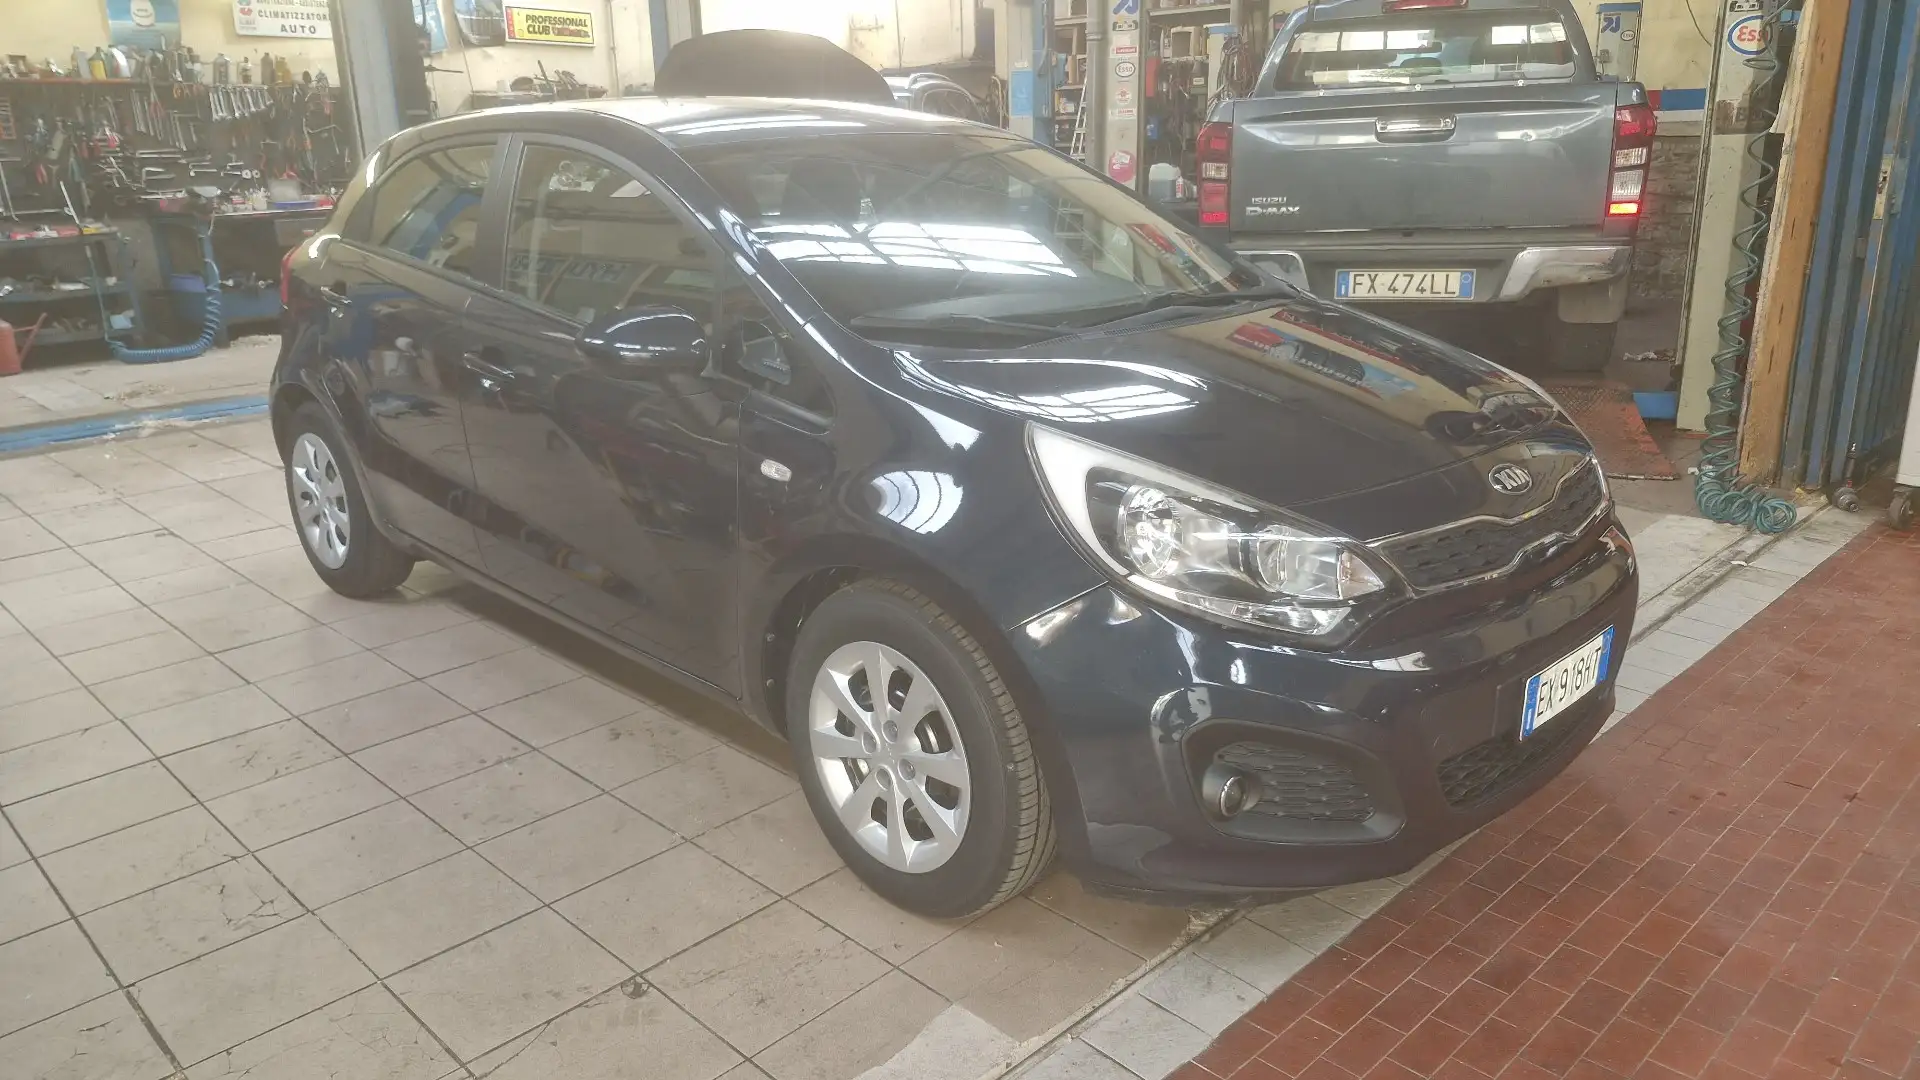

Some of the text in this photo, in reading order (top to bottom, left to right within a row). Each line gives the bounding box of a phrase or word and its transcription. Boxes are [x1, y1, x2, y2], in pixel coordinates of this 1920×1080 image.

[525, 14, 589, 28] PROFESSIONAL
[280, 23, 317, 35] AUTO
[526, 23, 551, 36] CLUB
[1251, 196, 1287, 205] ISUZU
